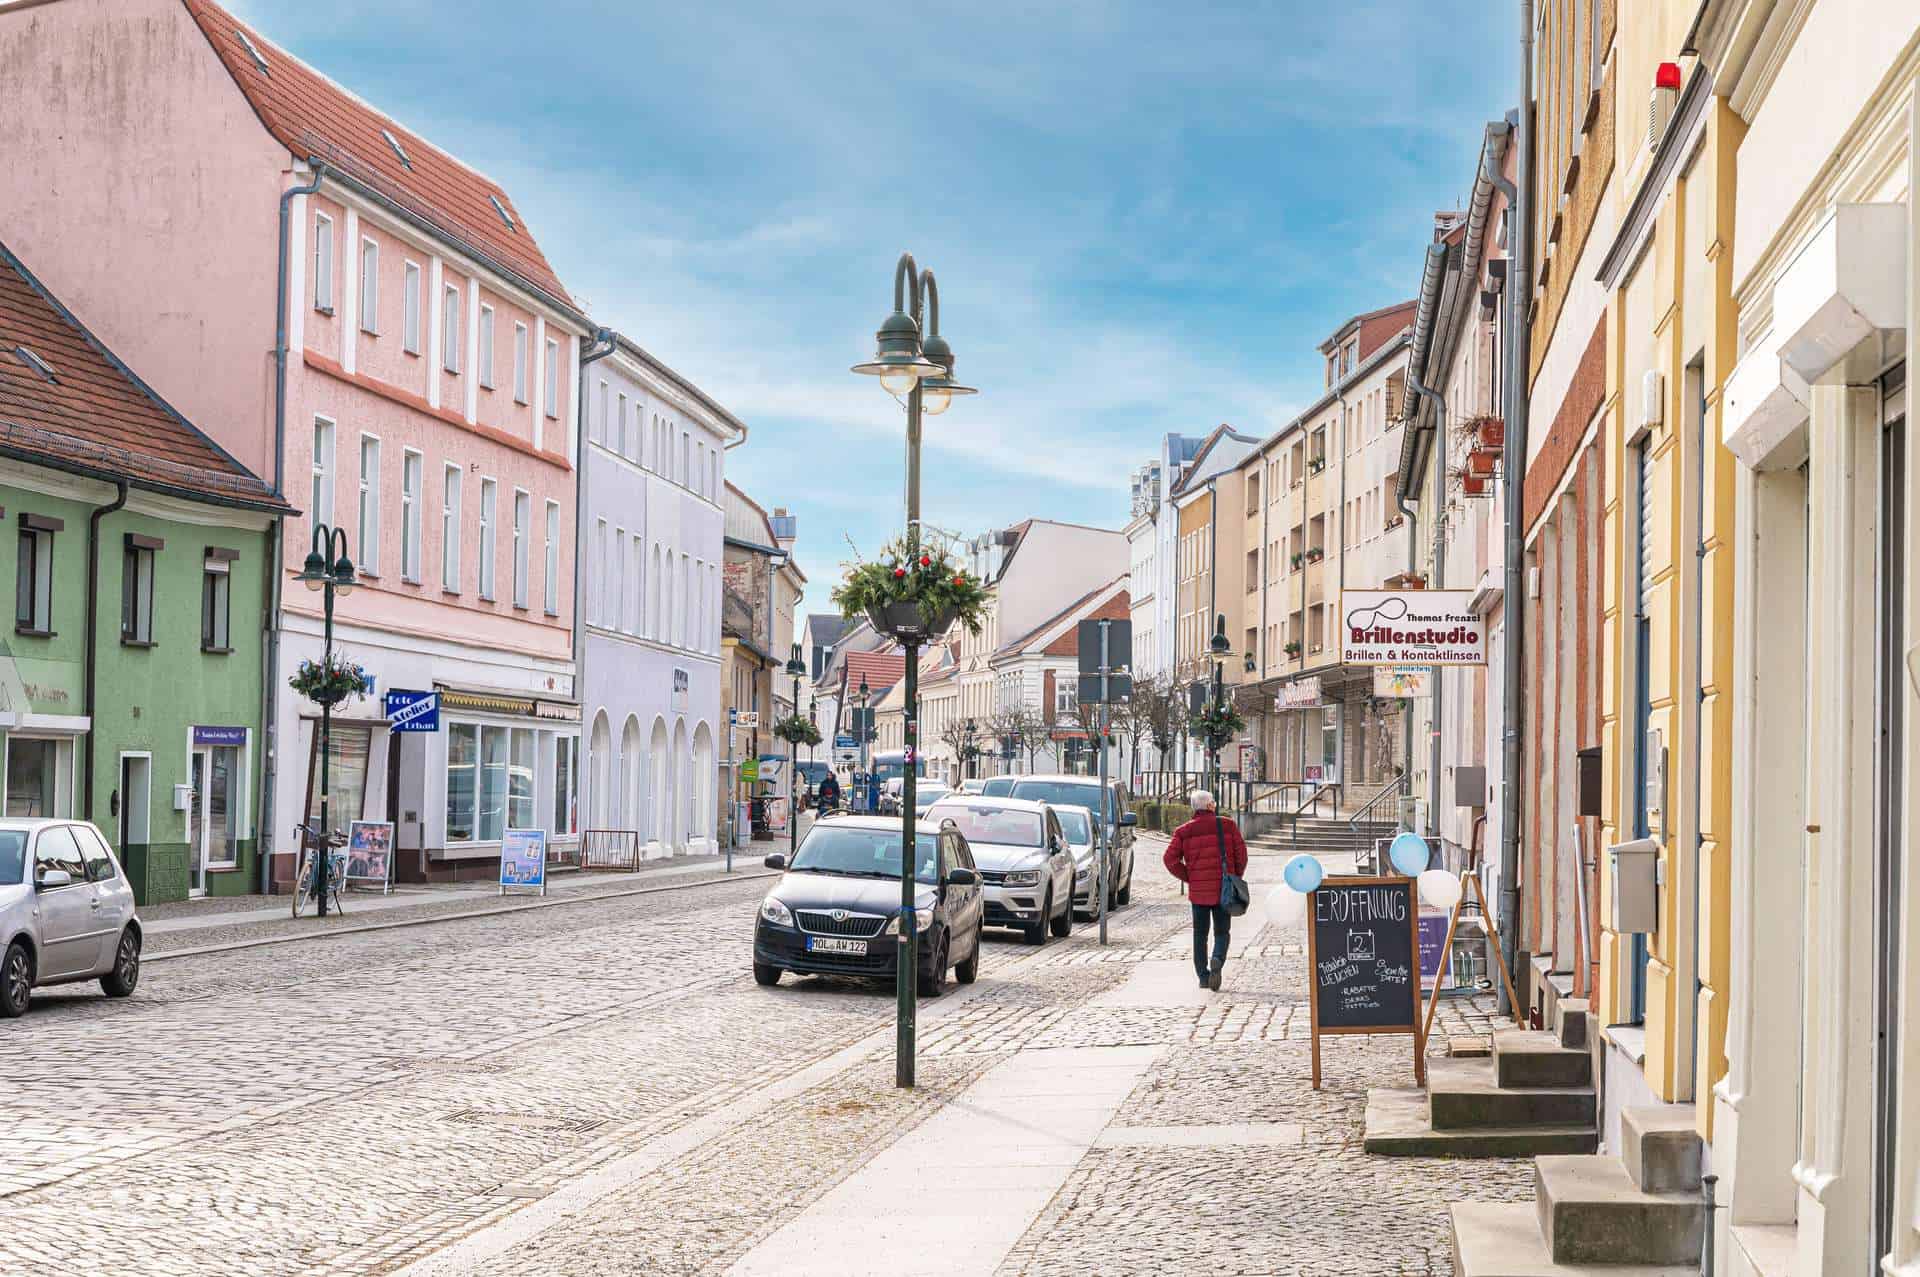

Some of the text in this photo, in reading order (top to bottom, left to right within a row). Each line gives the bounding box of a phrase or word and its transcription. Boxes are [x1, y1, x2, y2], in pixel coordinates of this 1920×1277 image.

[1407, 613, 1481, 622] Thomas Frenzel
[1351, 626, 1479, 645] Brillenstudio
[1345, 649, 1481, 660] Brillen & Kontaktlinsen
[393, 701, 432, 721] Atelier
[1317, 888, 1406, 922] ERÖFFNUNG
[813, 938, 829, 949] MOL
[850, 941, 866, 952] 122
[1352, 935, 1367, 953] 2
